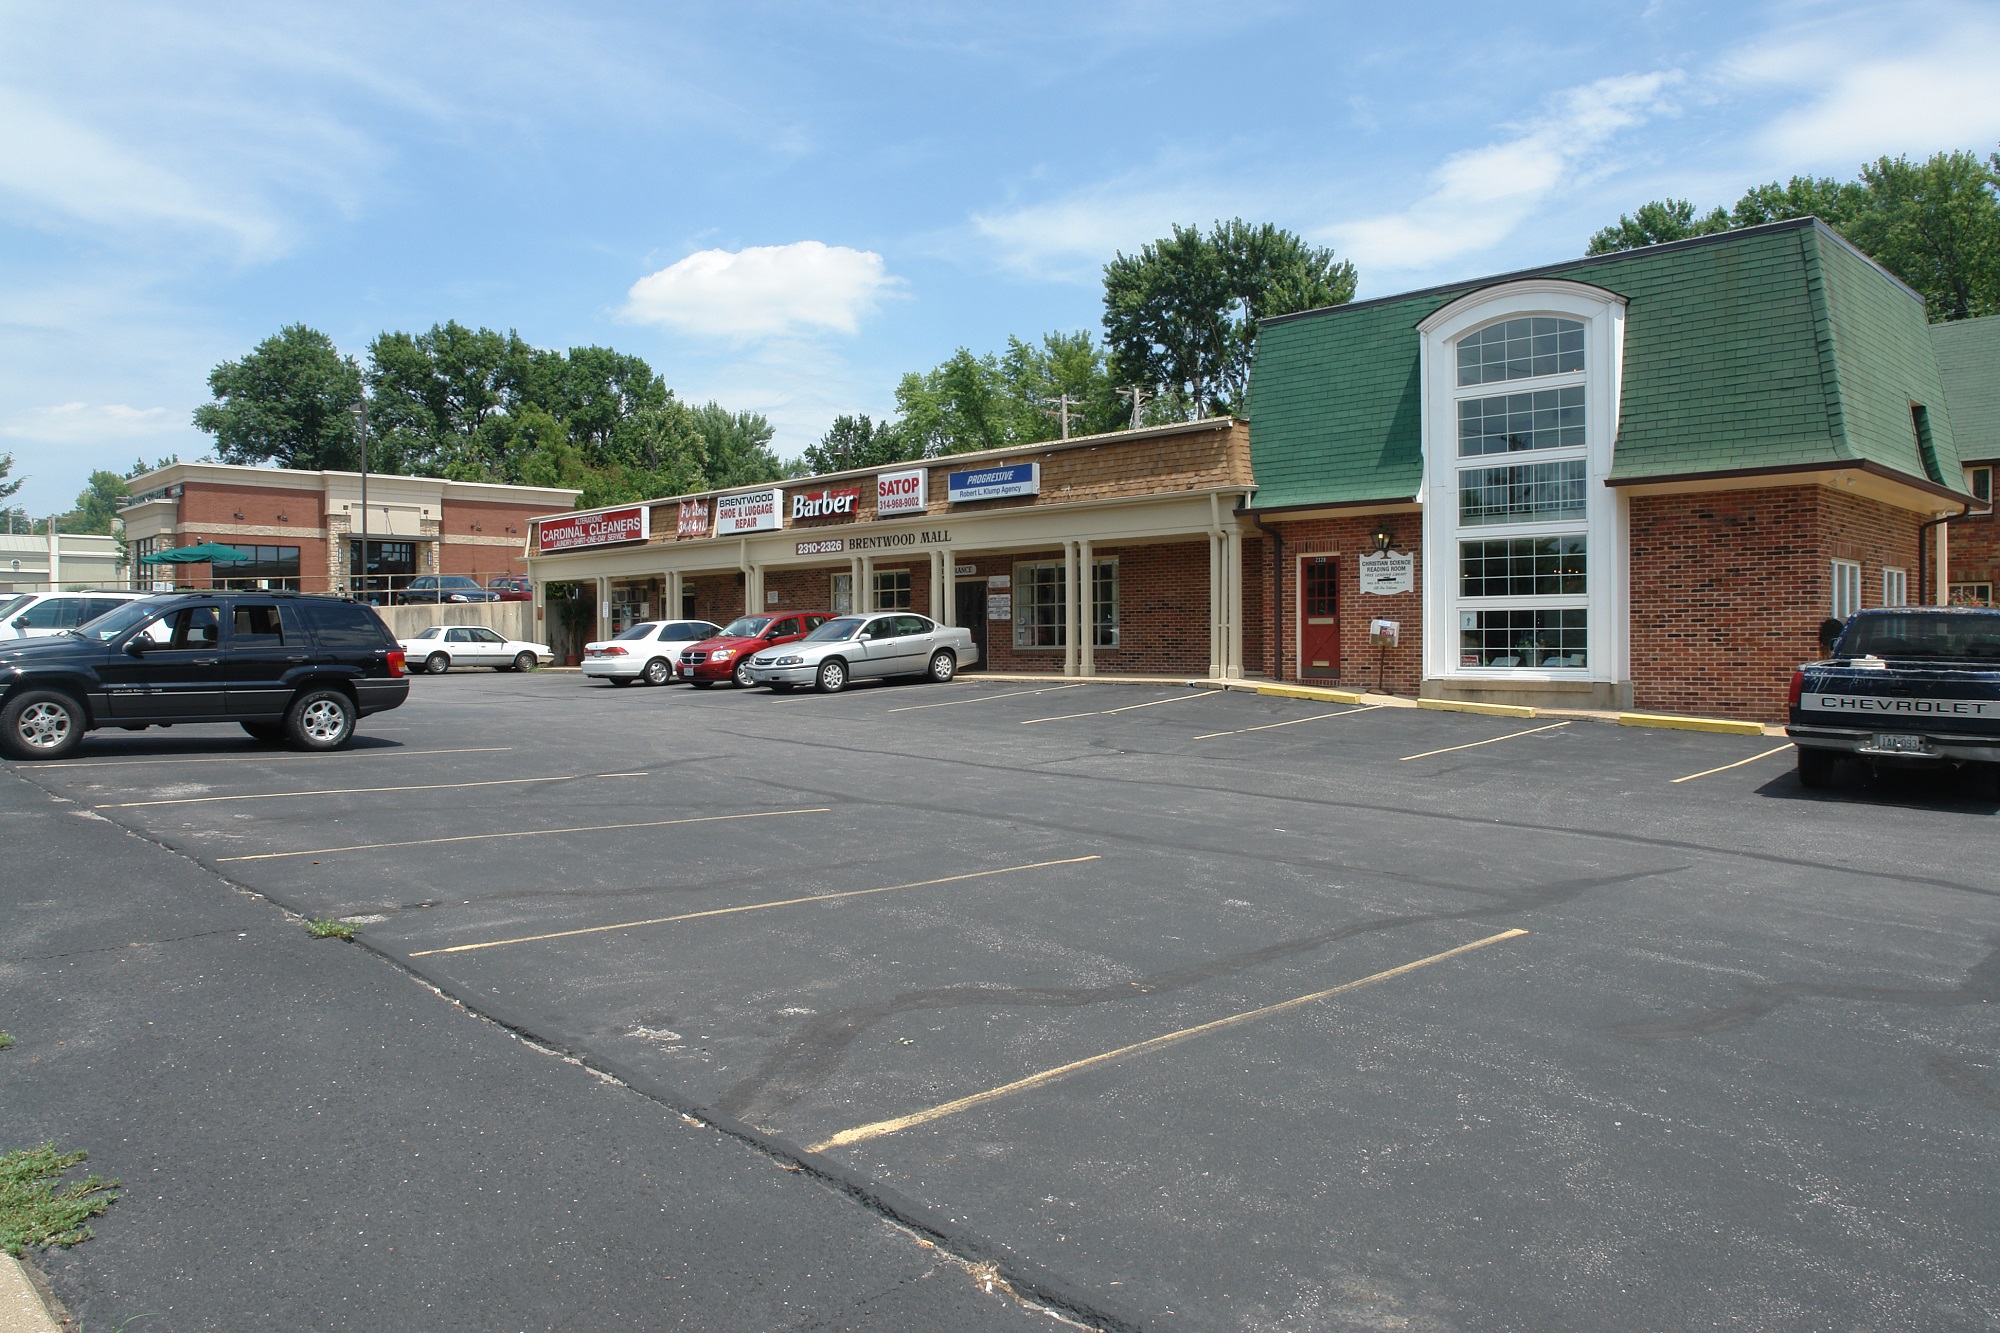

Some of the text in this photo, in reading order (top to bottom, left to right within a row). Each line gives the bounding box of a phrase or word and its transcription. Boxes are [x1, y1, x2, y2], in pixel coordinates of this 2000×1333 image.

[967, 471, 1014, 485] PROGRESSIVE
[879, 477, 919, 497] SATOP
[984, 488, 1001, 497] Klump
[1001, 486, 1021, 494] Agency
[720, 493, 774, 507] BRENTWOOD
[792, 491, 854, 518] Barber
[720, 508, 736, 519] SHOE
[738, 507, 743, 517] &
[745, 503, 773, 516] LUGGAGE
[575, 515, 603, 525] ALTERATIONS
[735, 517, 757, 529] REPAIR
[542, 518, 641, 542] CARDINAL CLEANERS
[607, 532, 627, 541] SERVICE
[849, 530, 952, 550] BRENTWOOD MALL
[798, 541, 842, 554] 2310-2326
[1821, 697, 1987, 714] CHEVROLET
